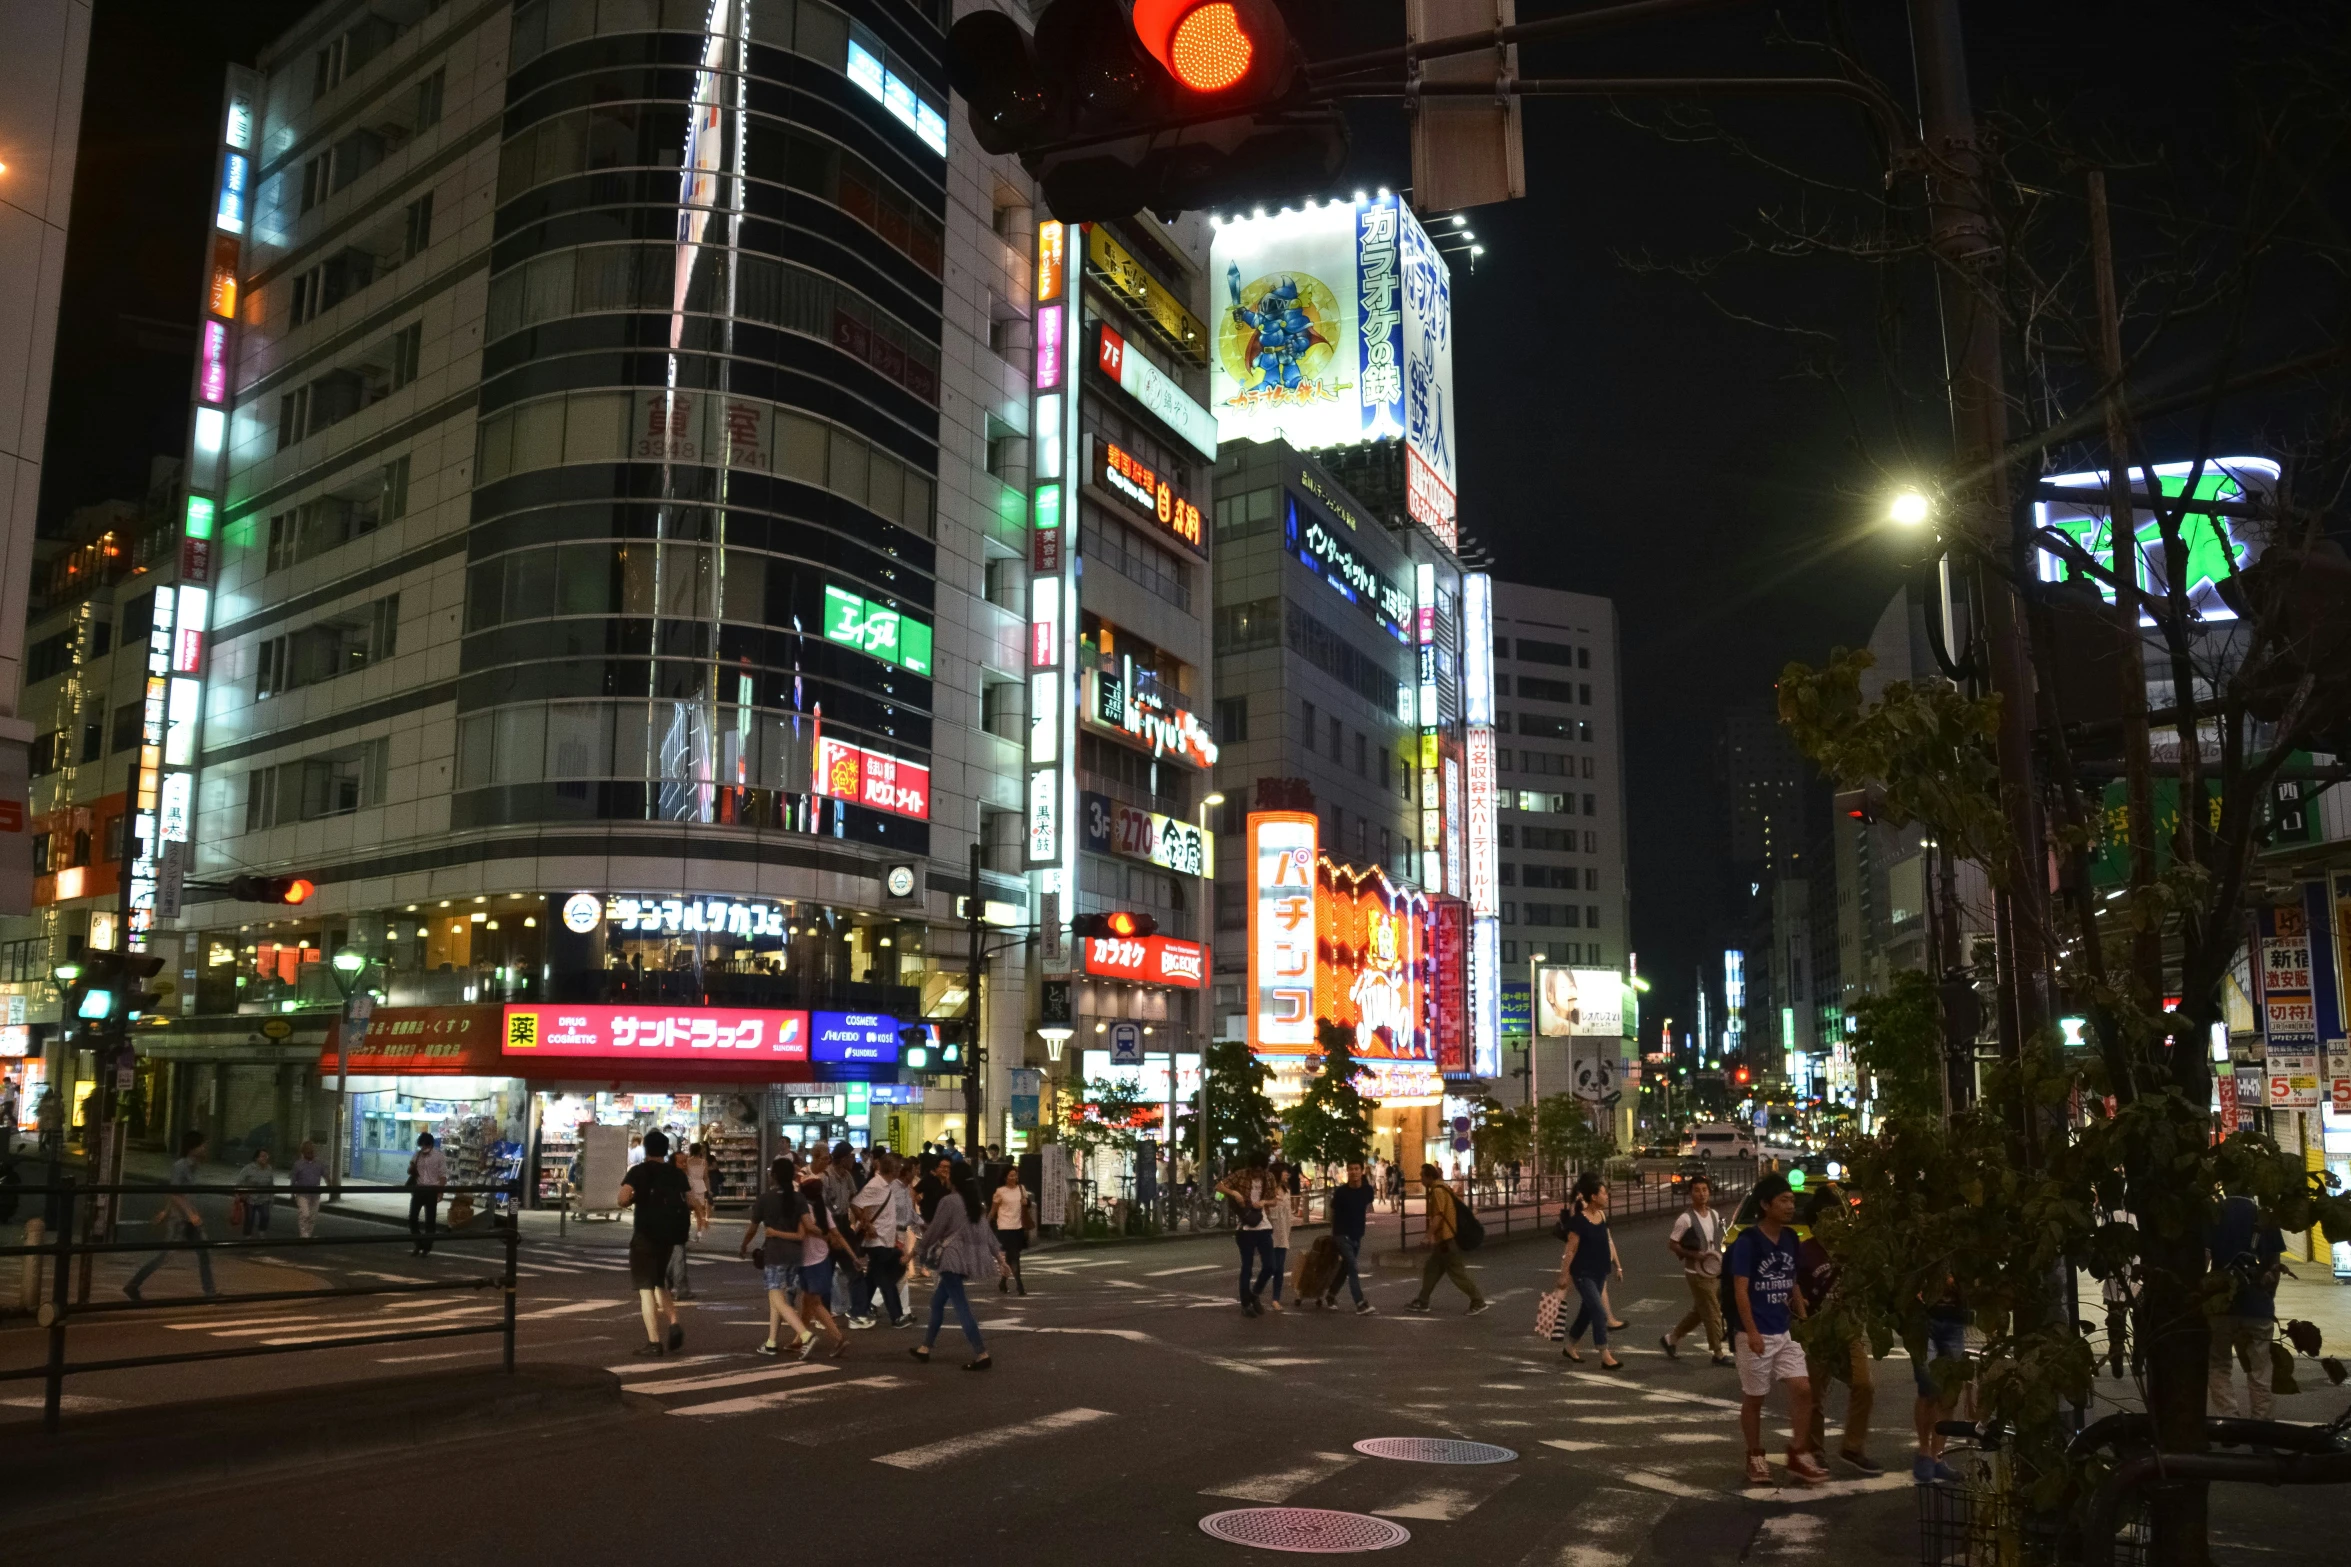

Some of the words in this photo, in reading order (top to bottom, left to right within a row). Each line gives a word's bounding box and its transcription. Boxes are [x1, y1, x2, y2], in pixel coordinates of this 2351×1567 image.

[1360, 204, 1403, 441] カラオケの鉄人
[1103, 340, 1120, 367] 7F
[1231, 382, 1340, 414] カラオケの鉄人
[1107, 444, 1154, 494] 韓国料理
[865, 778, 924, 813] ハウスメイト
[1036, 805, 1050, 852] 黒太鼓
[1089, 802, 1111, 839] 3F
[614, 899, 784, 937] サンマルクカフェ
[1273, 847, 1312, 1025] パチンコ
[1093, 937, 1146, 969] カラオケ
[1161, 951, 1179, 974] BIG
[511, 1016, 534, 1044] 薬
[558, 1017, 587, 1026] DRUG
[611, 1016, 763, 1049] サンドラッグ
[845, 1015, 878, 1026] COSMETIC
[547, 1033, 597, 1045] COSMETIC
[772, 1044, 802, 1052] SUNDRUG
[821, 1029, 860, 1042] SHISEIDO
[852, 1048, 878, 1057] SUNDRUG
[2271, 1077, 2290, 1098] 5
[2292, 1089, 2303, 1097] %
[2331, 1079, 2351, 1103] 5
